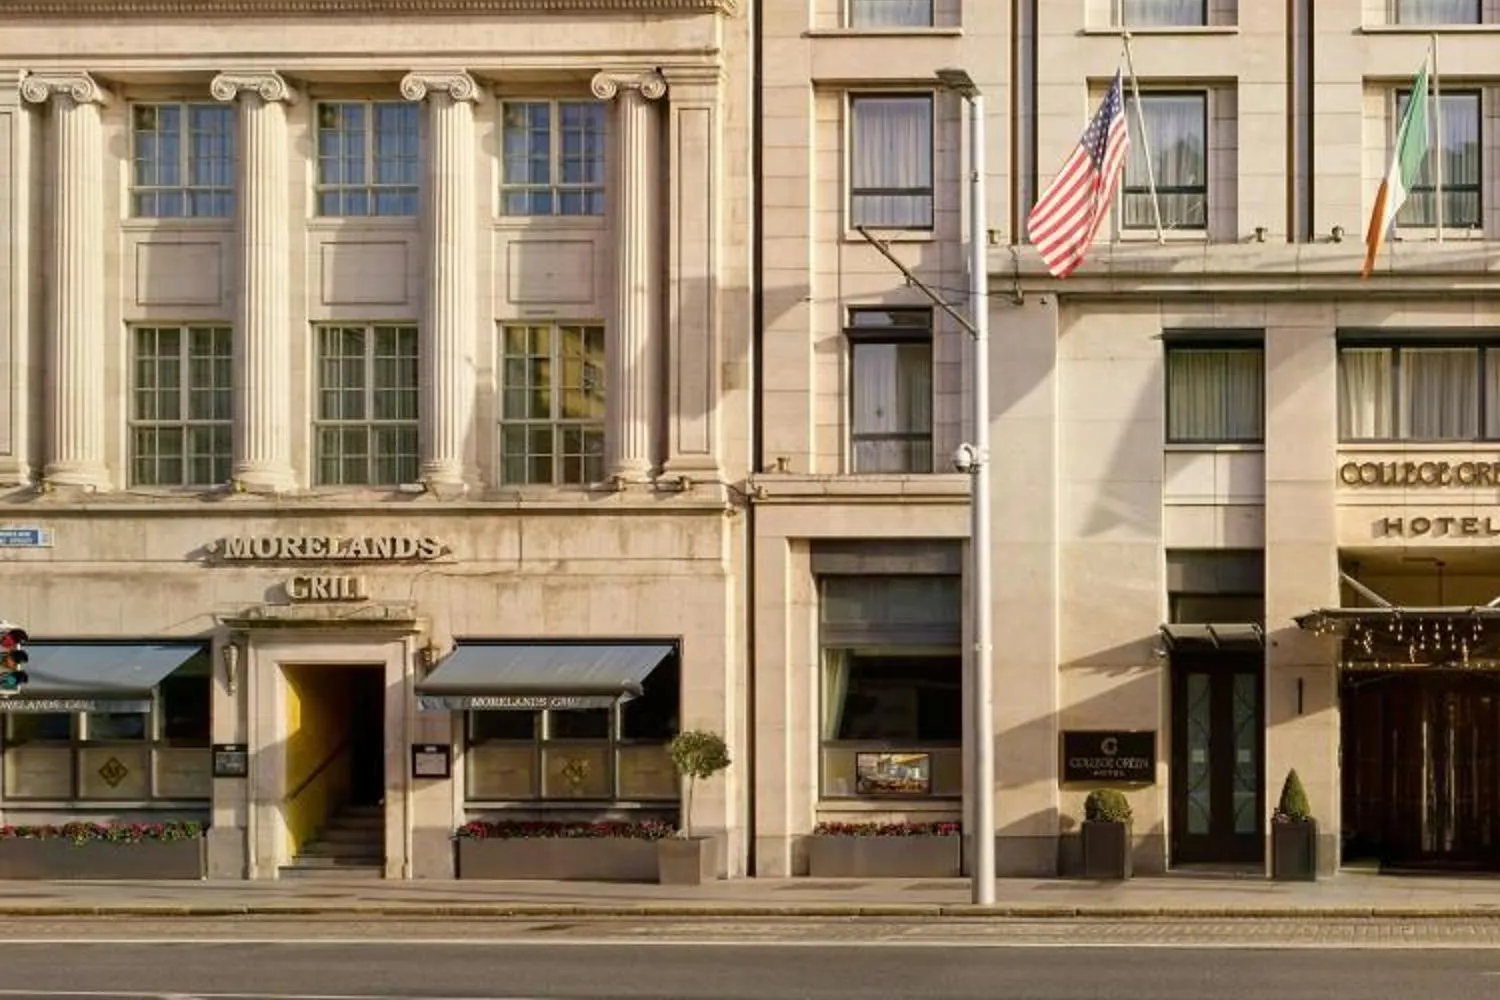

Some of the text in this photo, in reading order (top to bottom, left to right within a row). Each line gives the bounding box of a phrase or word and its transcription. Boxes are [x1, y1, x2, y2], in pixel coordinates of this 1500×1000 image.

[1339, 461, 1451, 486] COLLEGE
[222, 535, 442, 560] MORELANDS
[285, 575, 369, 600] GRILL
[471, 696, 547, 708] MORELANDS
